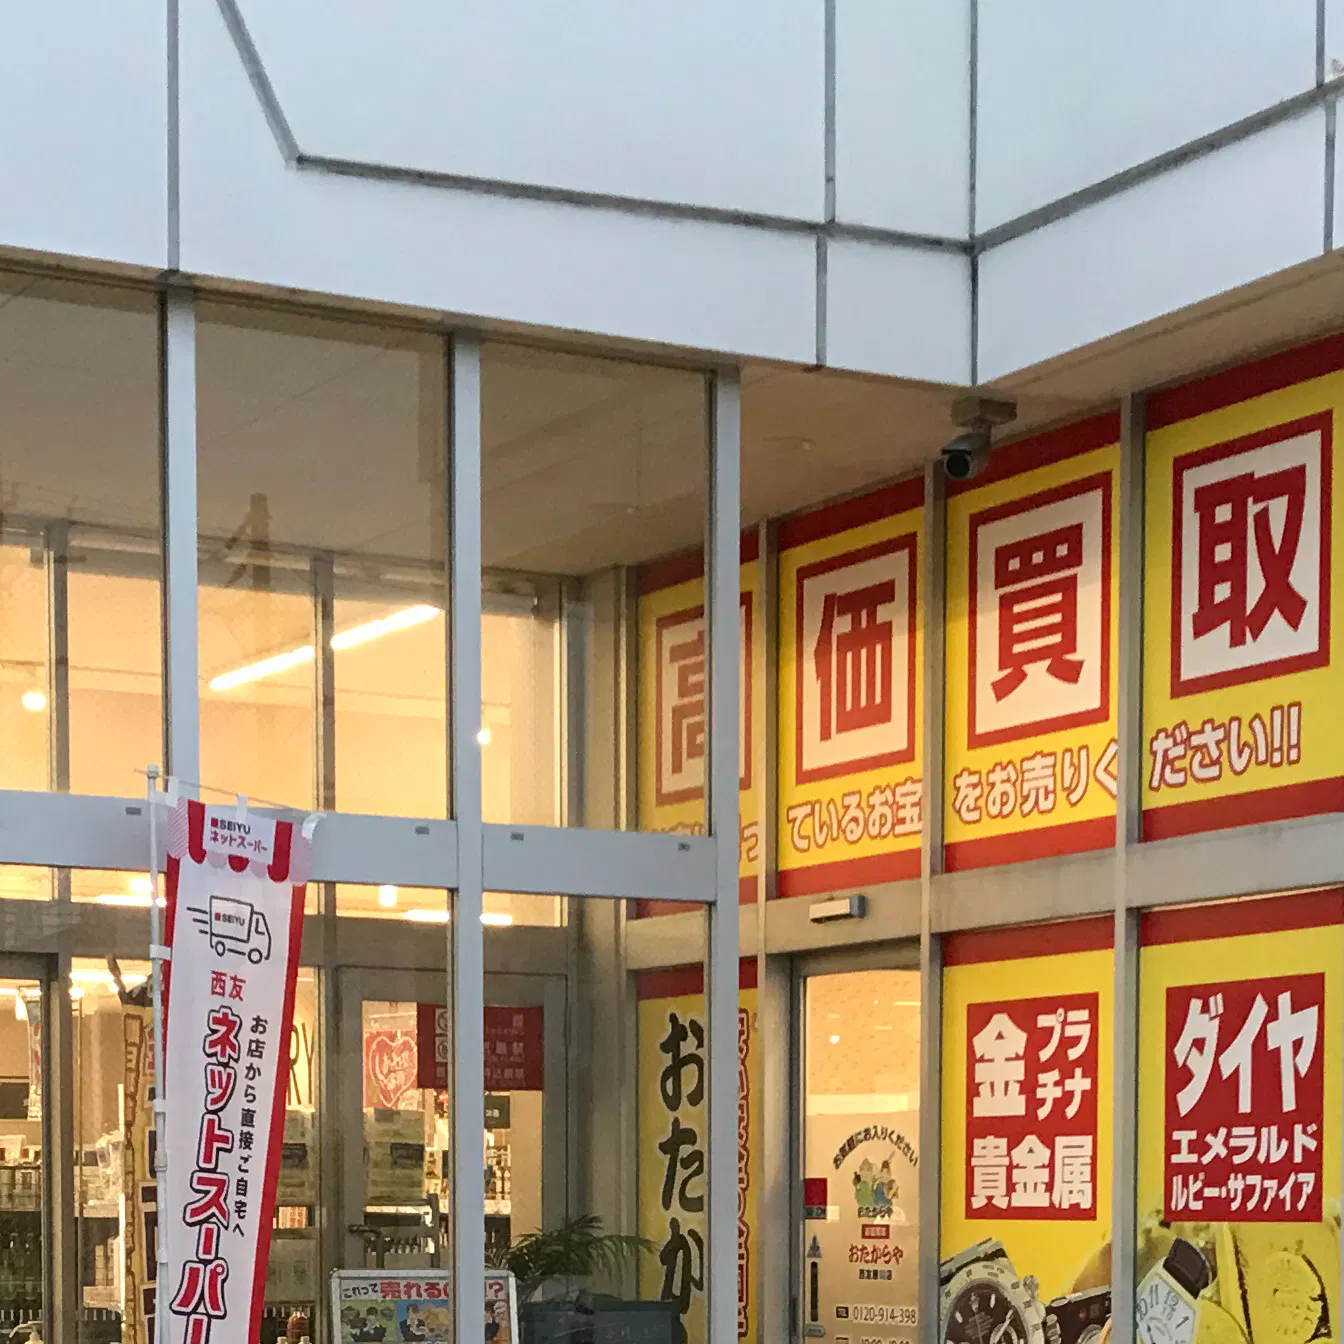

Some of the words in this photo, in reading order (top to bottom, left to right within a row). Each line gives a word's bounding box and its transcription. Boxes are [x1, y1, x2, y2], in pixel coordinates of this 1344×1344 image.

[813, 578, 896, 744] 価
[990, 522, 1085, 703] 買
[1191, 464, 1308, 650] 取
[952, 736, 1119, 826] をお売りく
[1149, 700, 1302, 791] ださい!!
[210, 831, 268, 853] ネットスーパー
[219, 819, 251, 835] SEIYU
[222, 914, 245, 927] SEIYU
[210, 970, 246, 1001] 西友
[972, 1012, 1028, 1118] 金
[1036, 1007, 1092, 1063] プラ
[1174, 991, 1319, 1118] ダイヤ
[1035, 1067, 1092, 1121] チナ
[232, 1015, 268, 1238] お店から直接ご自宅へ
[1170, 1123, 1318, 1165] エメラルド
[970, 1134, 1094, 1210] 貴金属
[1170, 1171, 1315, 1212] ルビー・サファイア
[849, 1244, 904, 1265] おたからや
